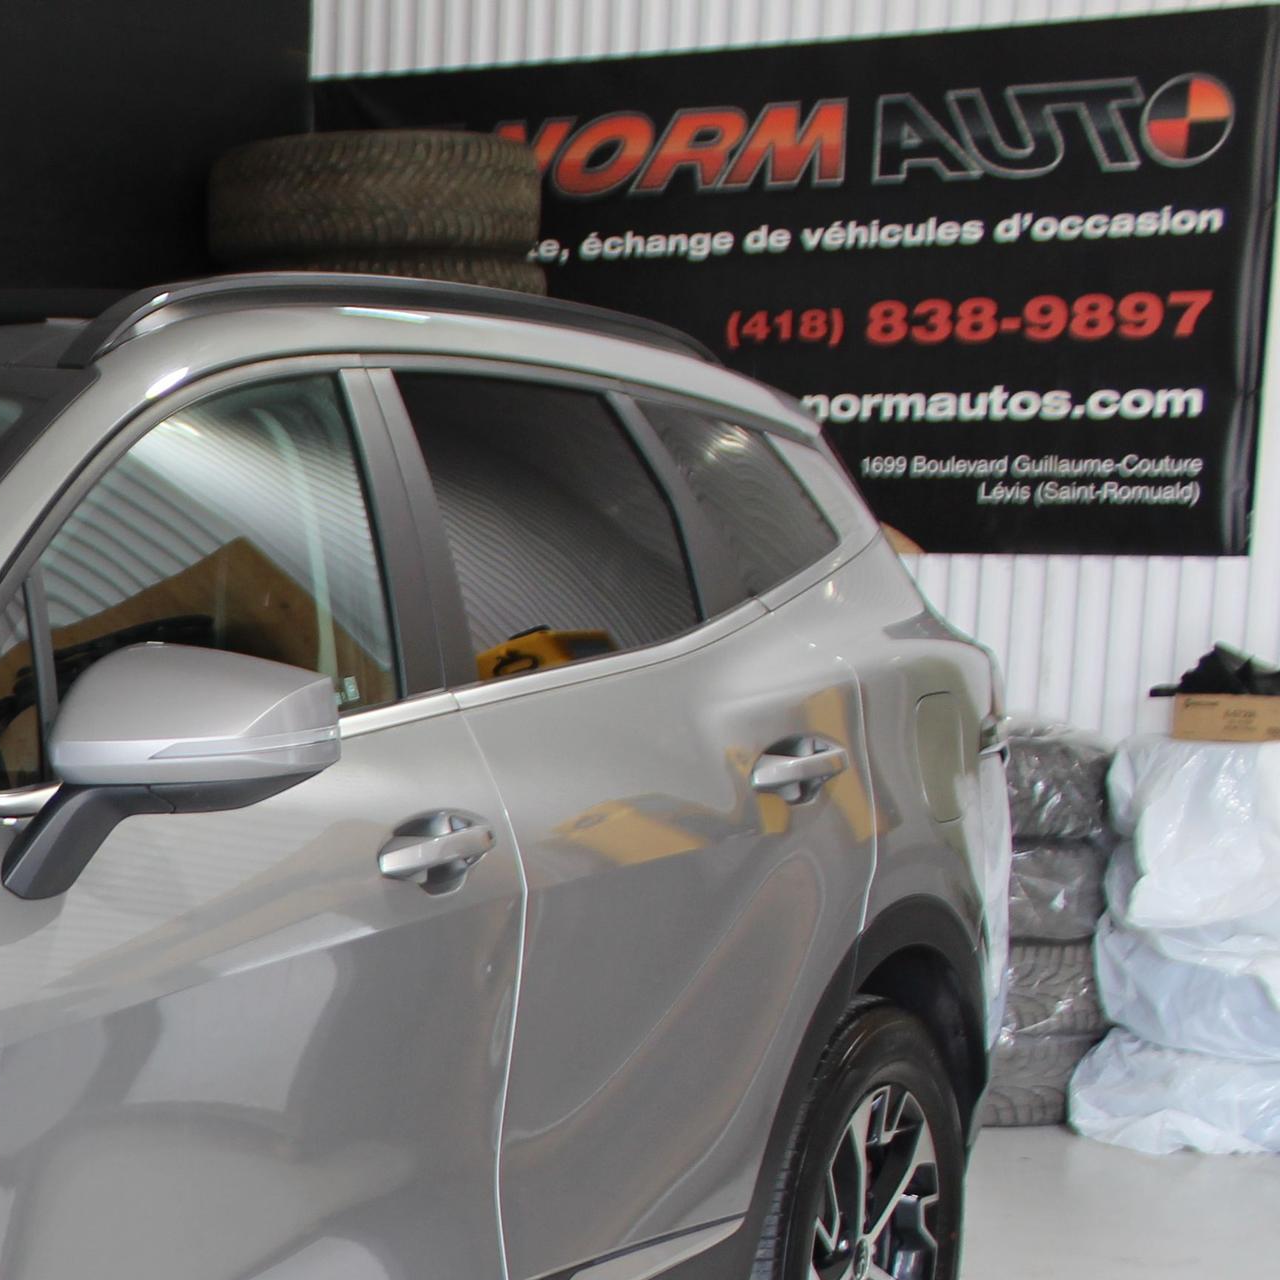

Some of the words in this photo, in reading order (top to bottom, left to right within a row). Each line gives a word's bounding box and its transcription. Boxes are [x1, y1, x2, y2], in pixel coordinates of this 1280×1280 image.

[872, 72, 1235, 185] AUTO
[579, 229, 734, 262] échange
[744, 225, 792, 255] de
[802, 217, 984, 253] véhicules
[993, 204, 1224, 244] d'occasion
[726, 306, 845, 347] (418)
[865, 290, 1213, 345] 838-9897
[800, 385, 1205, 423] normautos.com
[861, 456, 908, 476] 1699
[912, 454, 1009, 477] Boulevard
[1013, 453, 1203, 478] Guillaume-Couture
[977, 482, 1032, 505] Lévis
[1037, 481, 1201, 506] (Saint-Romuald)
